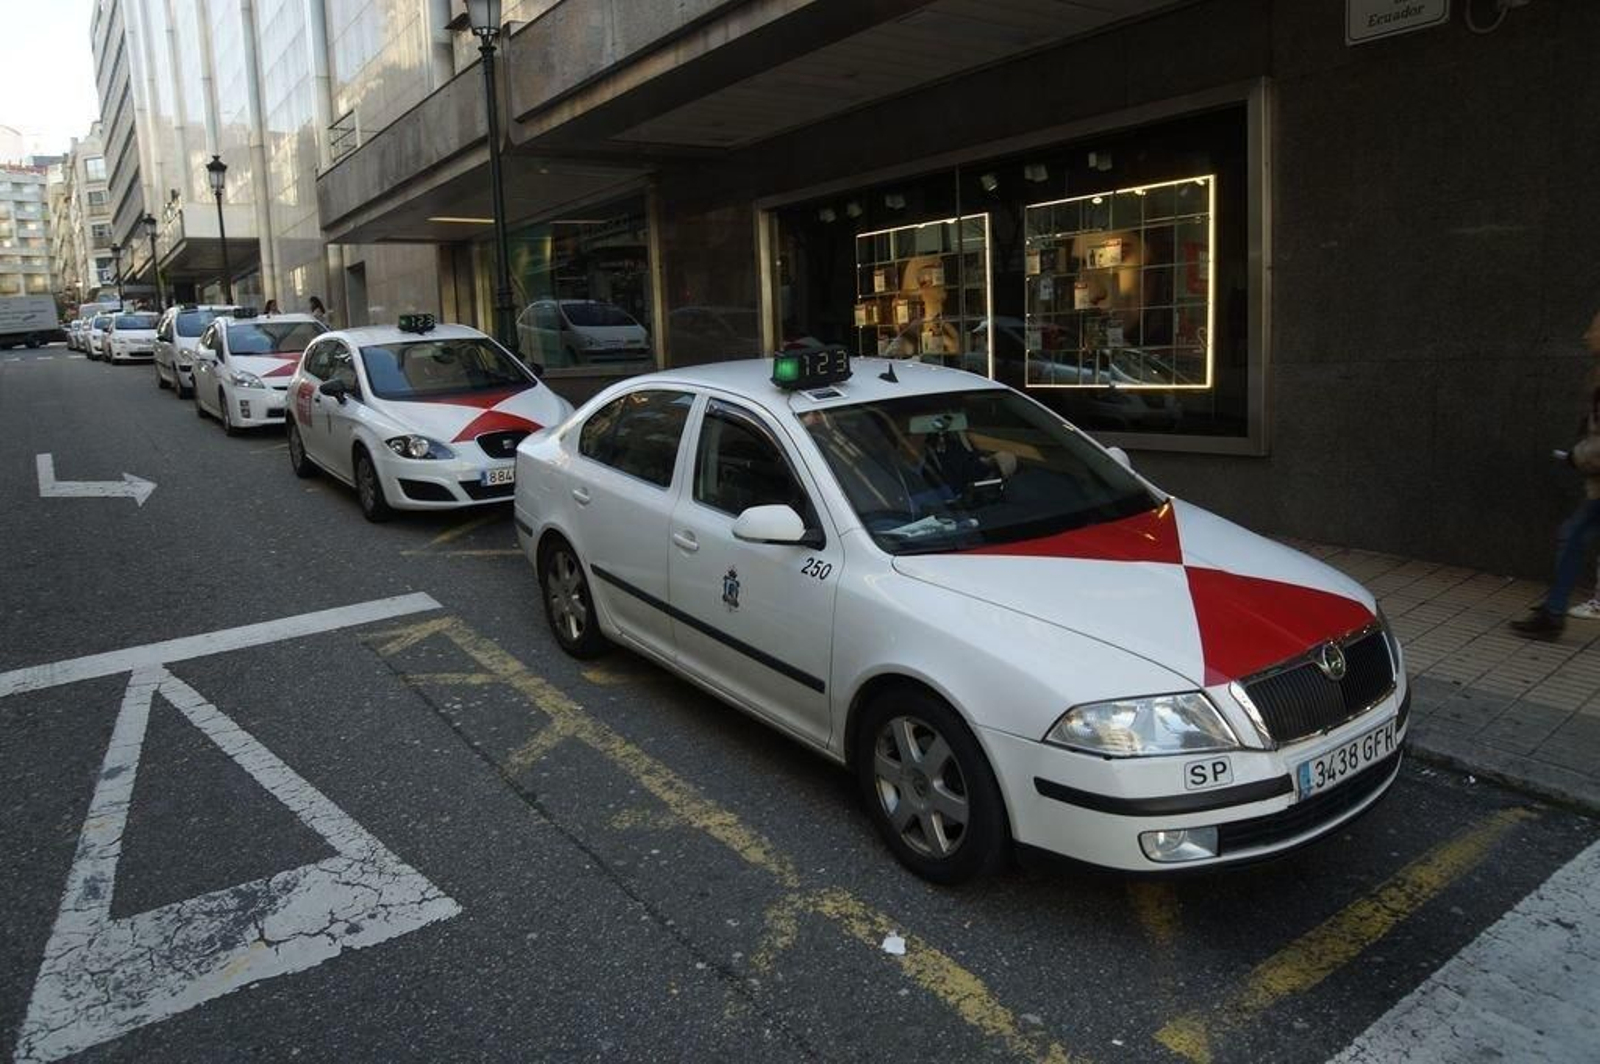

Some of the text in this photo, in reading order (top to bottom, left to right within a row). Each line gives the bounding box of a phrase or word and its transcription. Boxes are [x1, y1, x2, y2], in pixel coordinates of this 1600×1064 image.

[1367, 4, 1425, 27] Ecuador
[802, 350, 847, 376] 123
[489, 470, 513, 483] 884
[800, 557, 833, 580] 250
[1190, 761, 1227, 785] SP
[1315, 743, 1358, 788] 3438
